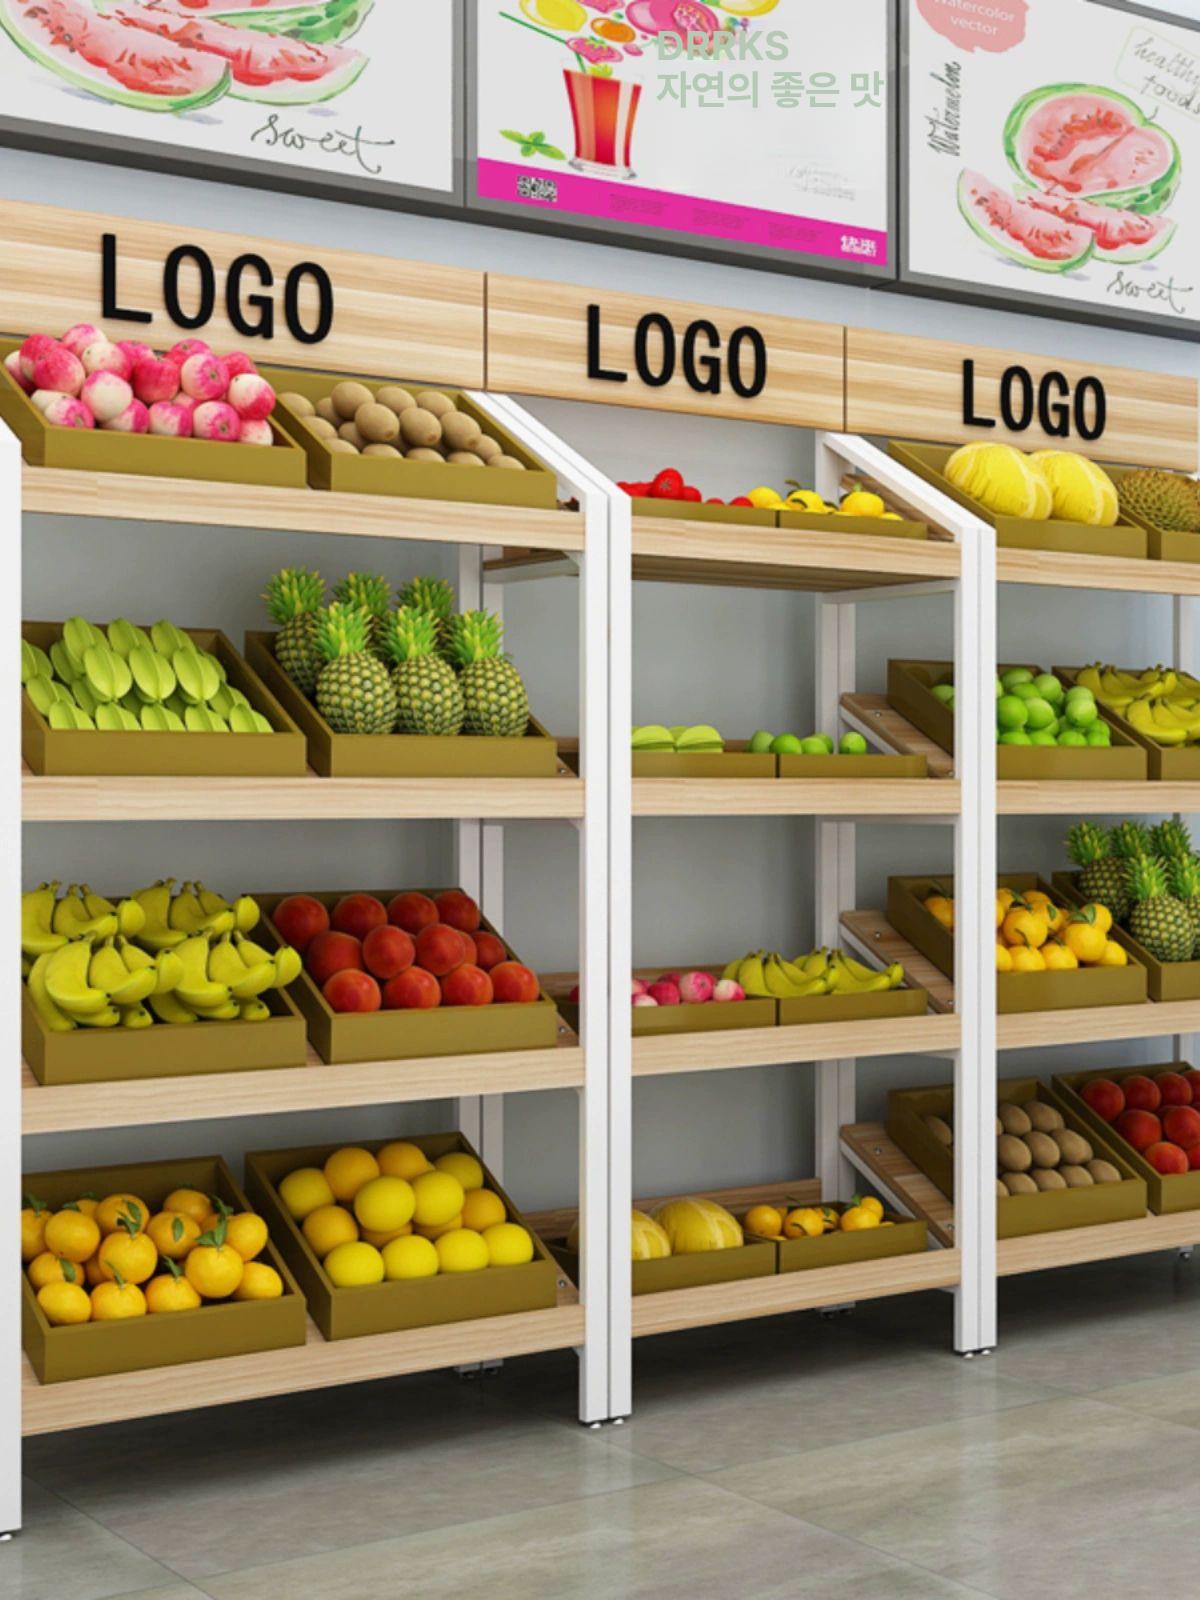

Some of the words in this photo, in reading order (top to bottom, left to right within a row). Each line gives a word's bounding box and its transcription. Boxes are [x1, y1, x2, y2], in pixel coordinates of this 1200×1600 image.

[949, 16, 999, 36] vector
[101, 233, 334, 345] LOGO
[587, 304, 767, 399] LOGO
[962, 359, 1107, 441] LOGO
